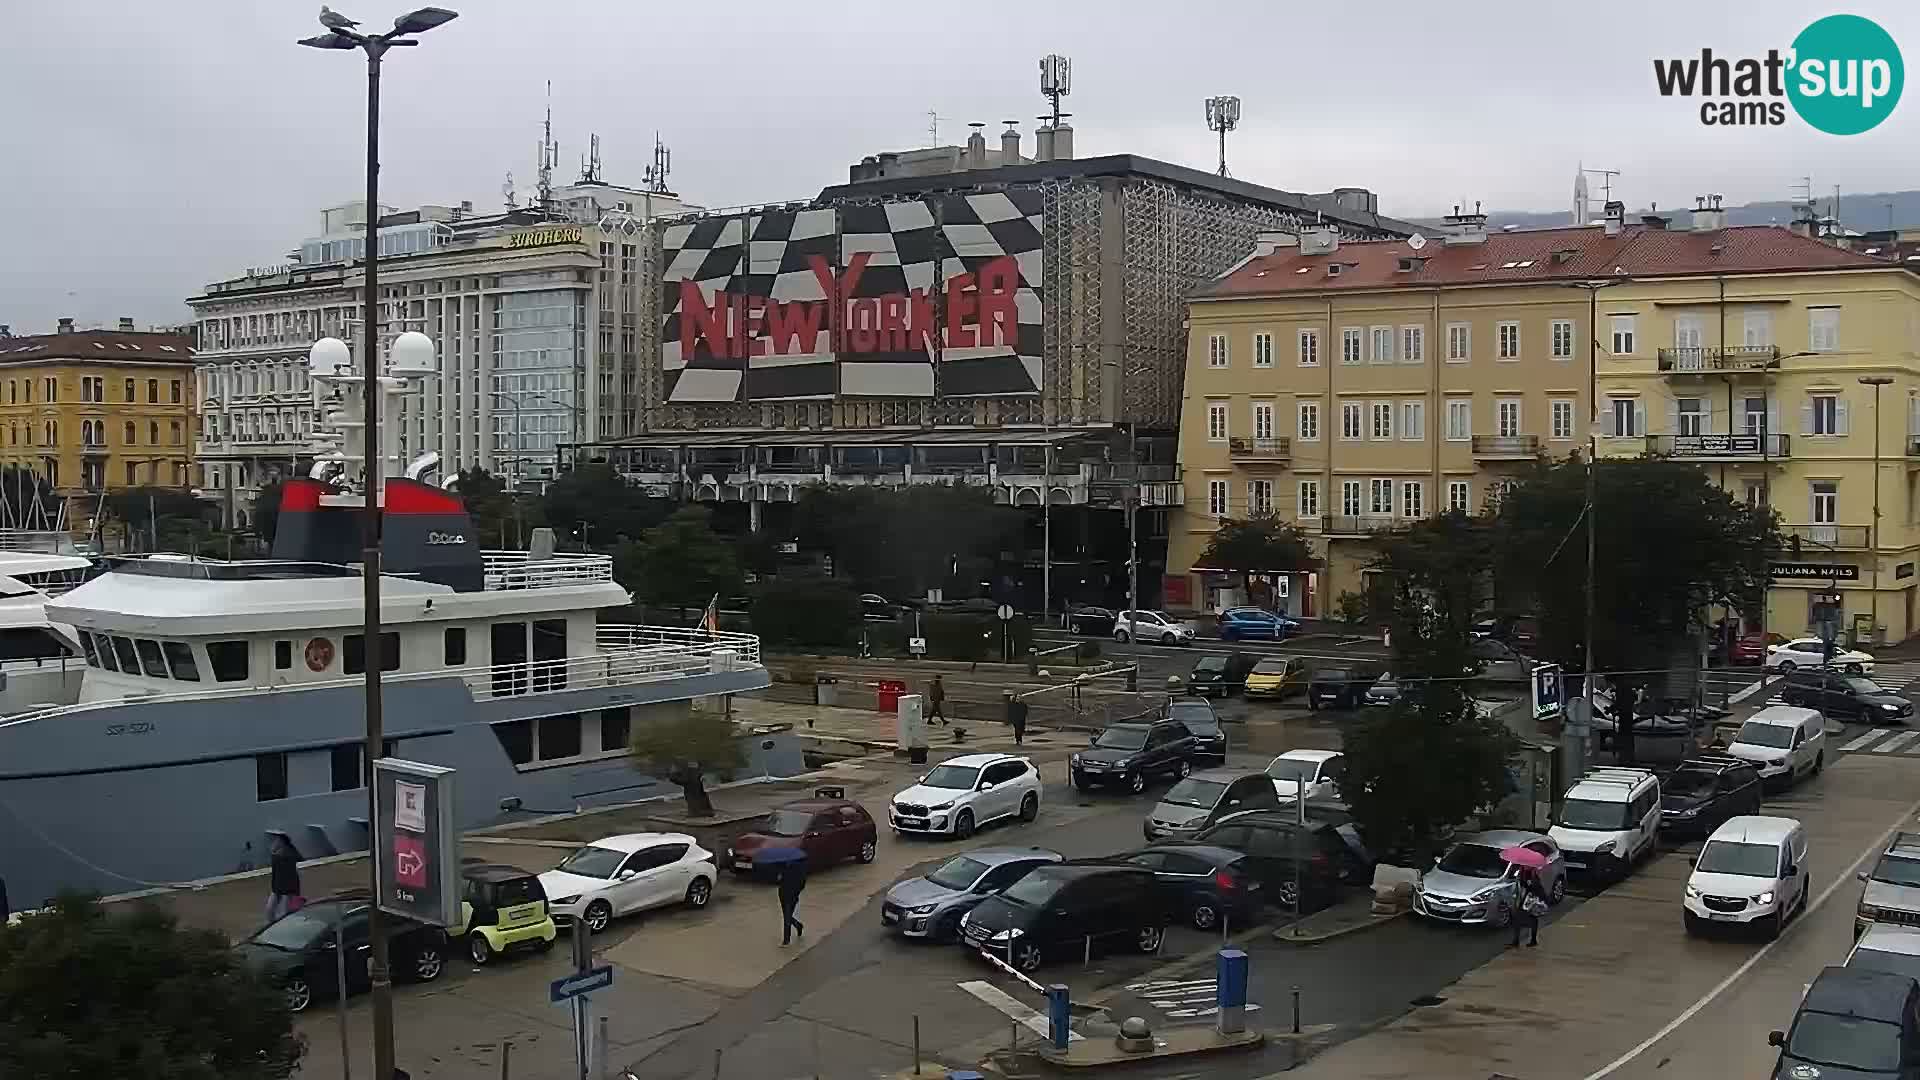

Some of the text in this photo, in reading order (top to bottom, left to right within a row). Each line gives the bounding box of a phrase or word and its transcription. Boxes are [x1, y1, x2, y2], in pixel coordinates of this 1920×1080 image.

[679, 251, 1020, 361] NEW YORKER
[1771, 566, 1853, 576] JULIANA NAILS
[396, 889, 415, 903] 5 km
